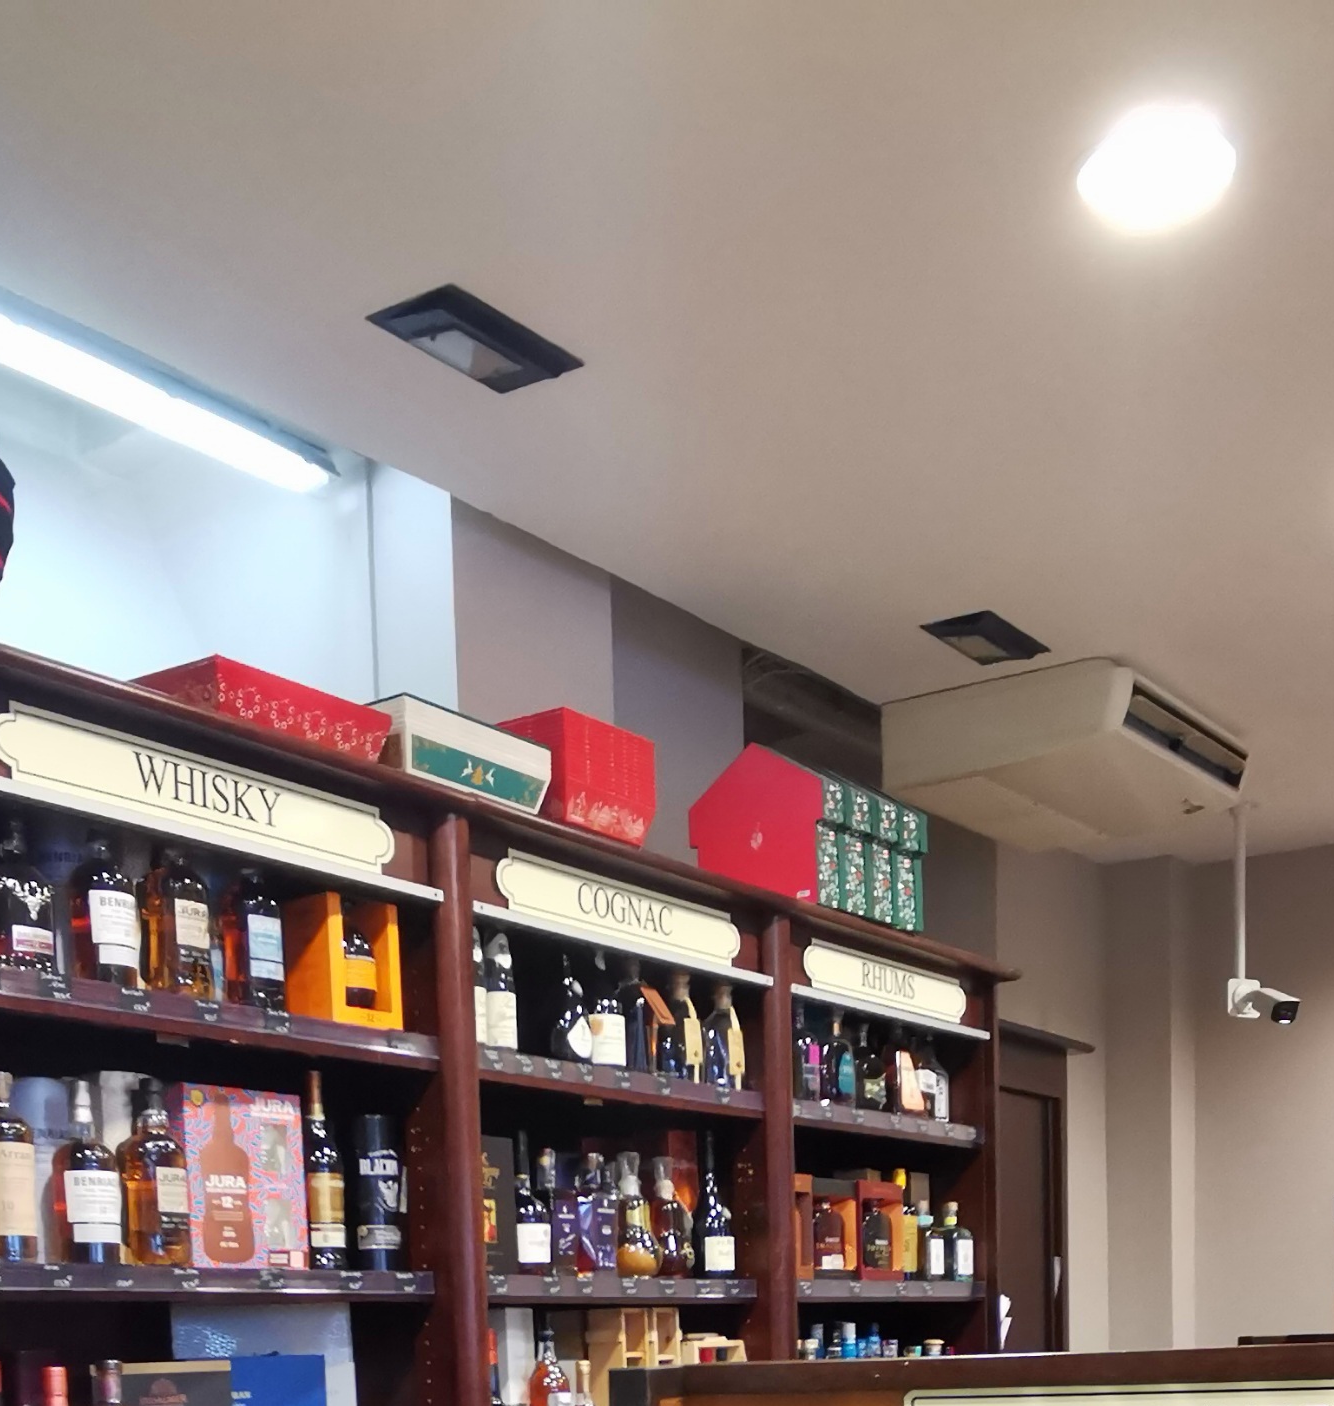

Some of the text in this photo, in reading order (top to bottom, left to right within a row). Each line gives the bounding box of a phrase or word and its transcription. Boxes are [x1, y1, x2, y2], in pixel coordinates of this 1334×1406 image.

[132, 750, 282, 829] WHISKY
[576, 881, 674, 938] COGNAC
[860, 960, 916, 1001] RHUMS
[249, 1096, 295, 1115] JURA
[204, 1174, 248, 1190] JURA
